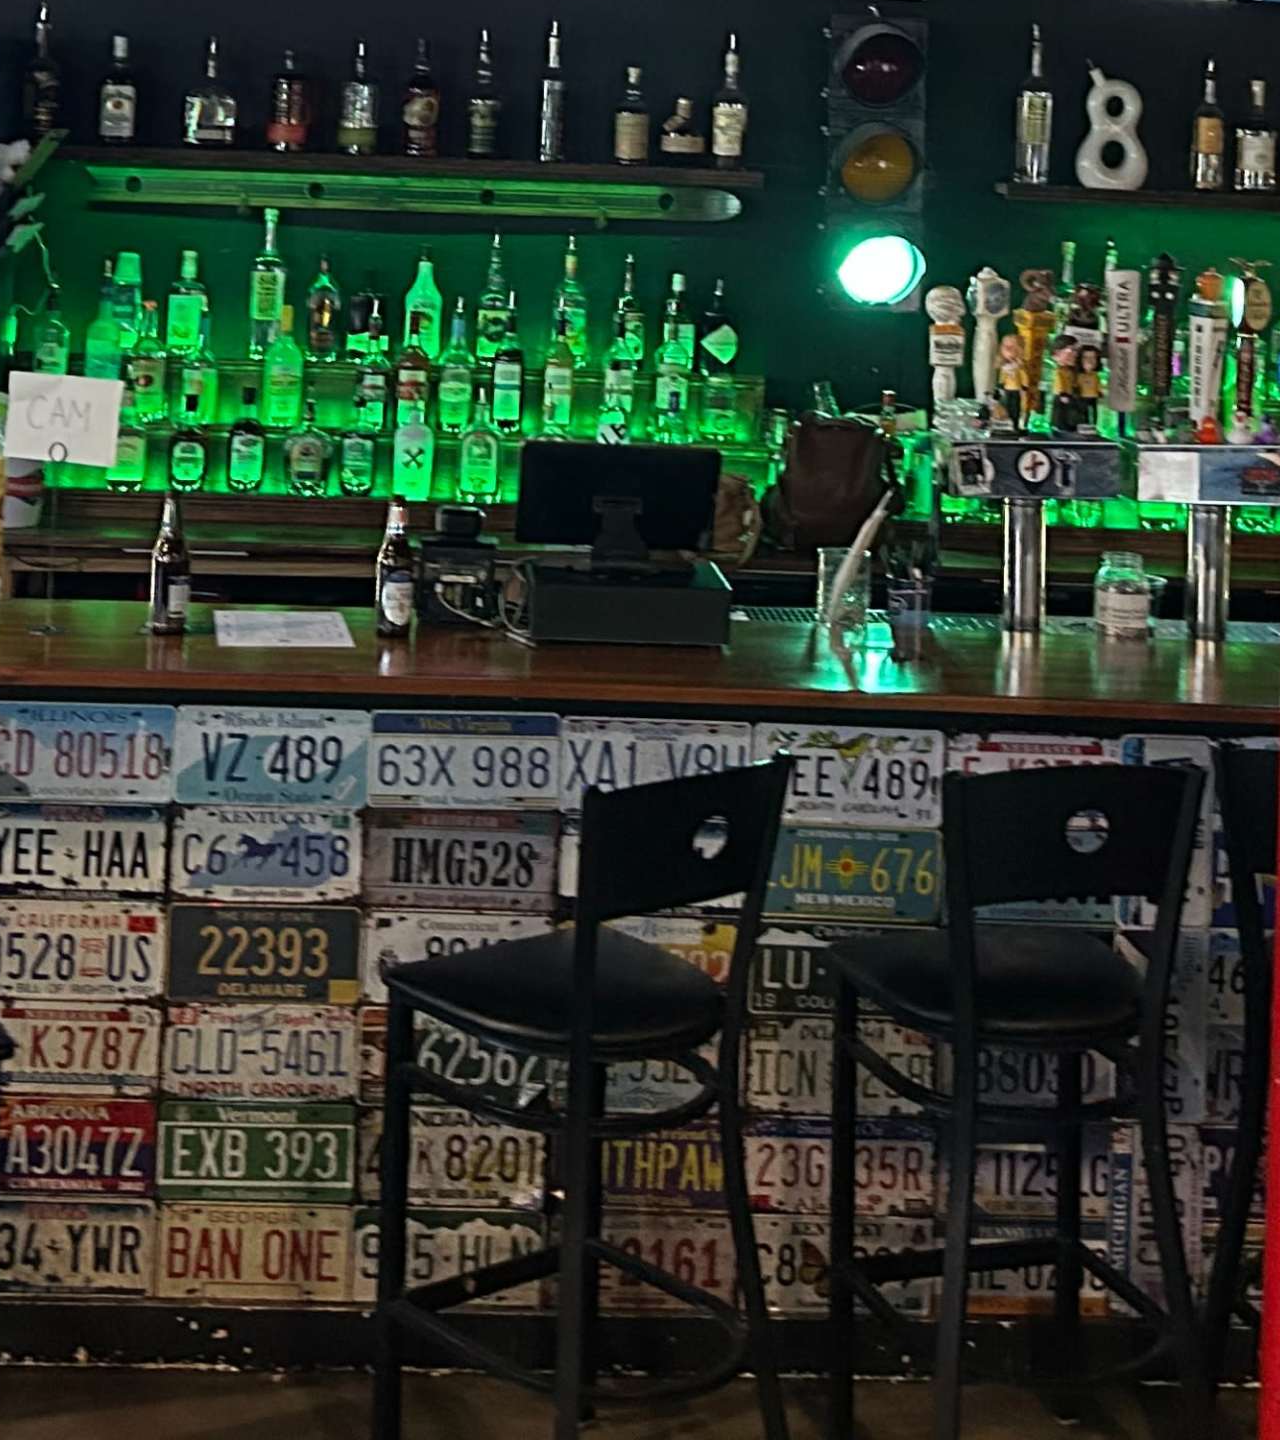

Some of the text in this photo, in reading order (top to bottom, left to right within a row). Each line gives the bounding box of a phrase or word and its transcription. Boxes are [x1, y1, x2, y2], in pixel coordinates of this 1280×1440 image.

[1116, 279, 1133, 334] ULTRA
[26, 394, 92, 433] CAM
[30, 709, 127, 725] ILLINOIS
[376, 742, 552, 790] 63X 988
[219, 809, 321, 826] KENTUCKY
[83, 830, 150, 879] HAA
[391, 836, 537, 889] HMG528
[794, 893, 897, 910] NEW MEXICO
[105, 933, 153, 985] US
[197, 924, 331, 981] 22393
[217, 982, 307, 999] DELAWARE
[29, 1017, 148, 1072] K3787
[12, 1104, 111, 1121] ARIZONA
[218, 1106, 300, 1124] Vermont
[171, 1127, 339, 1180] EXB 393
[7, 1177, 104, 1191] CENTENNIAL
[207, 1209, 303, 1225] GEORGIA
[1111, 1166, 1131, 1272] MICHIGAN
[165, 1226, 340, 1282] BAN ONE
